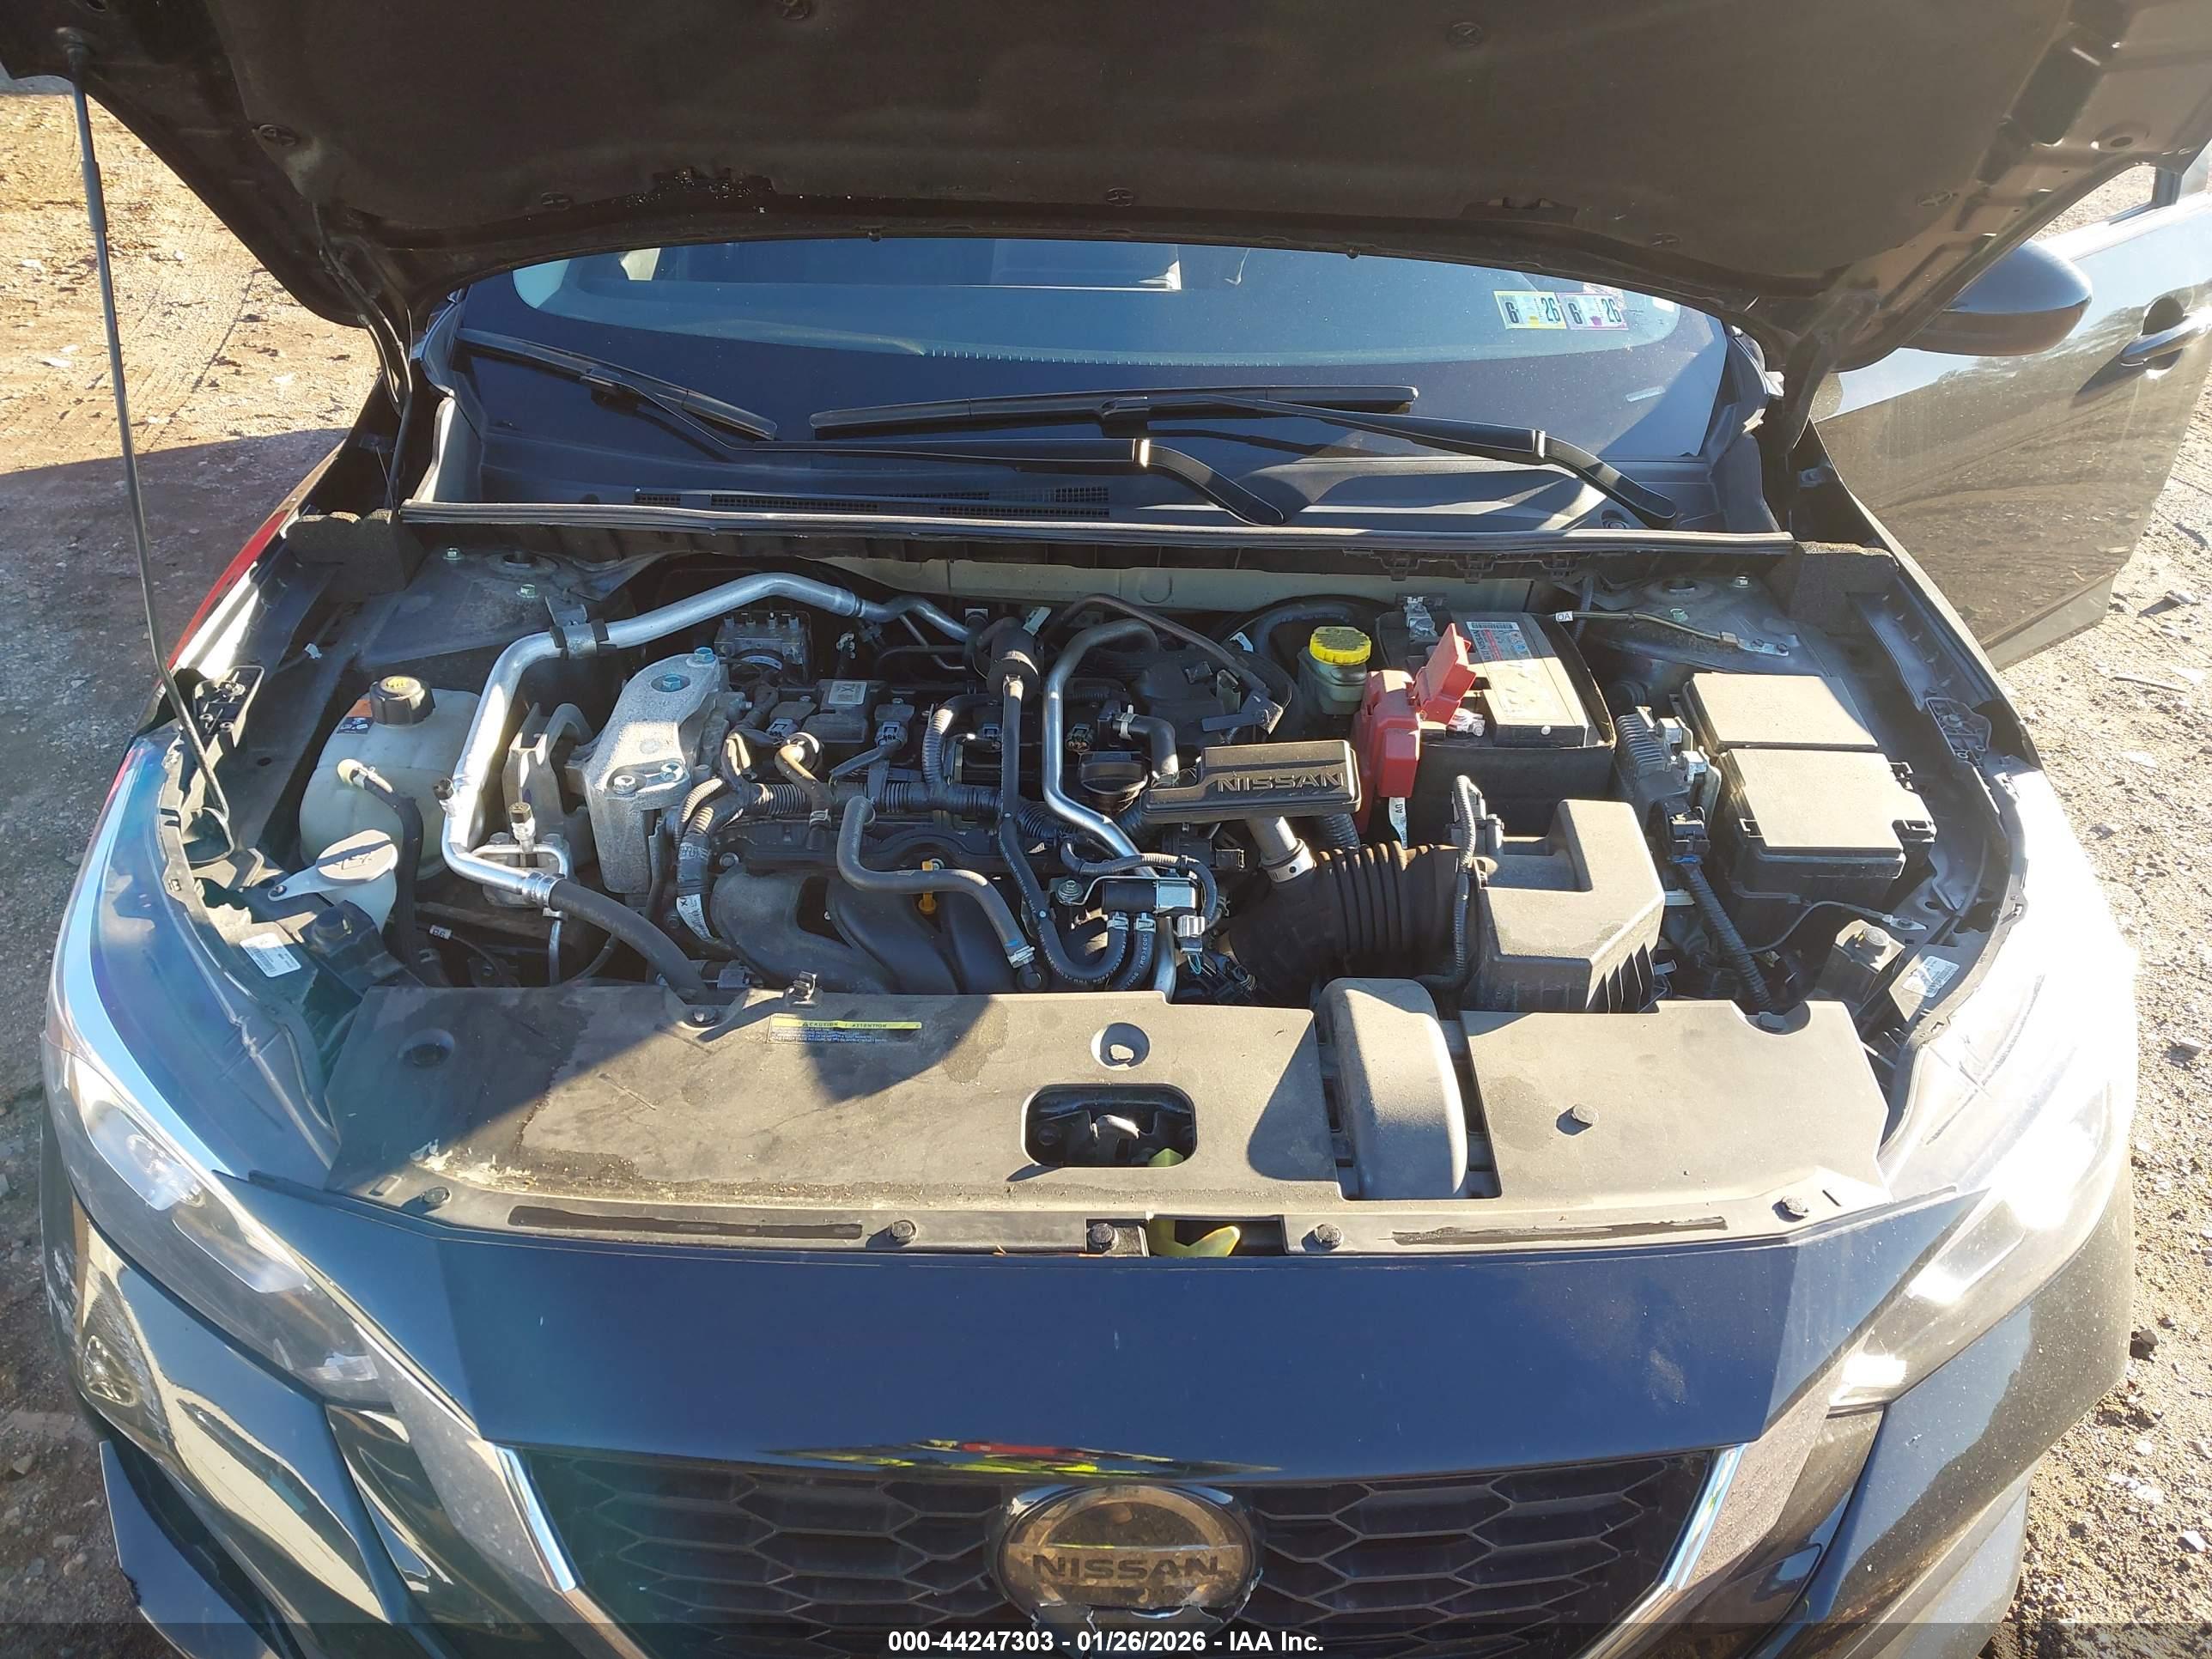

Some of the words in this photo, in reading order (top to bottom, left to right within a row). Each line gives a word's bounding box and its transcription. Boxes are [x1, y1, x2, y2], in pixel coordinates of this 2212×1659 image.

[1540, 297, 1561, 323] 26
[1601, 298, 1622, 323] 26
[1217, 772, 1344, 792] NISSAN
[1032, 1554, 1220, 1580] NISSAN
